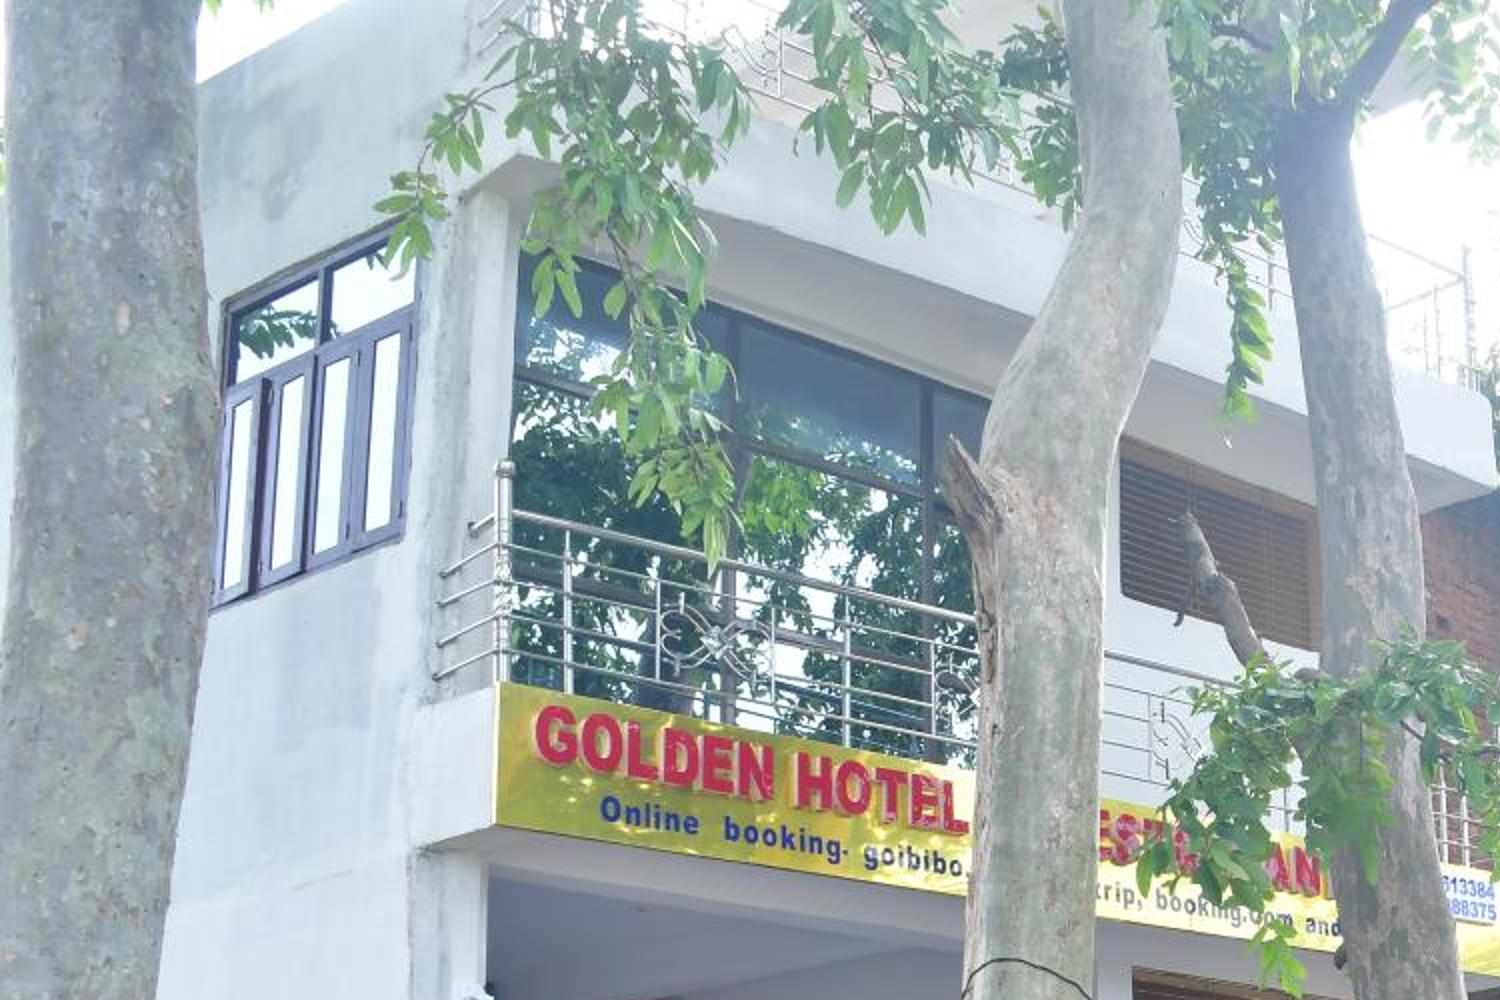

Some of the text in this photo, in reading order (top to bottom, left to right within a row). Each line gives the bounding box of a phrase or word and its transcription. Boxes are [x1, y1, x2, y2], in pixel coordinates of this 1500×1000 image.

[534, 704, 775, 803] GOLDEN
[793, 750, 970, 836] HOTEL
[600, 795, 700, 835] Online
